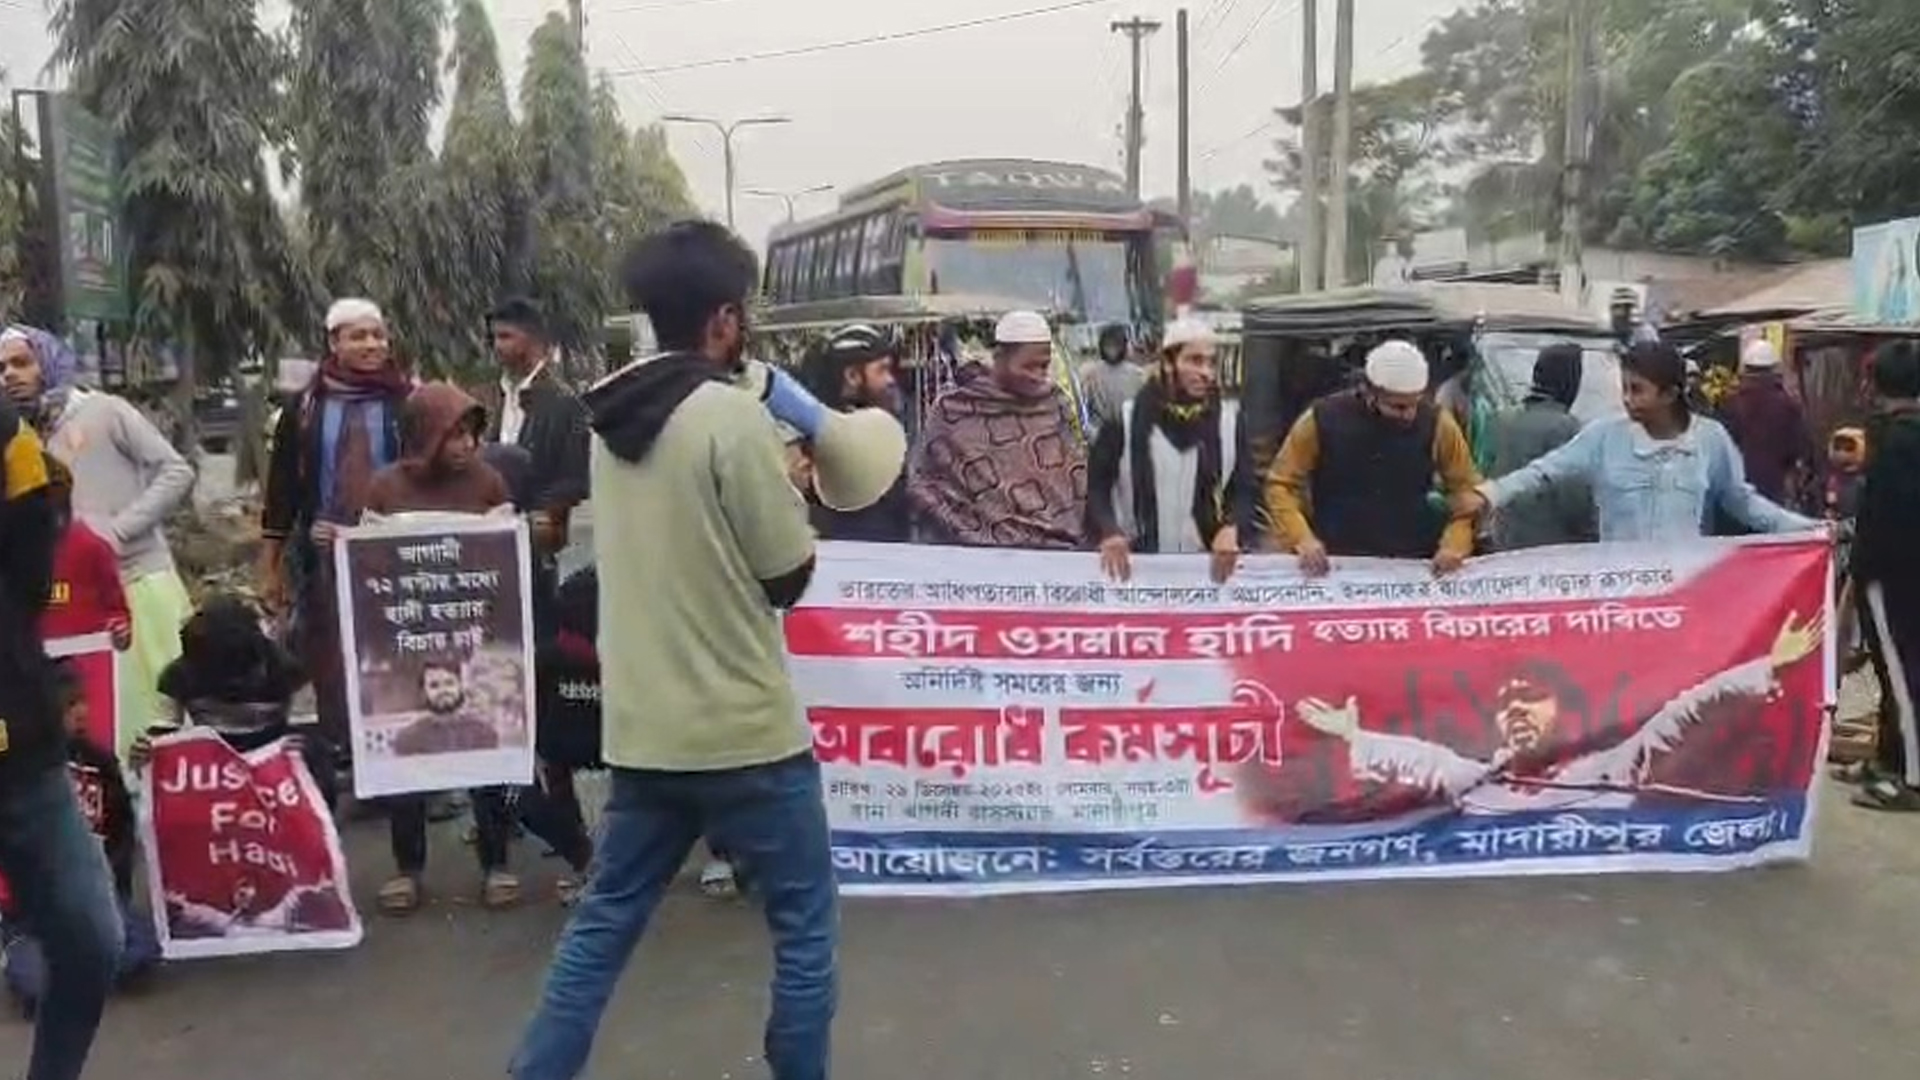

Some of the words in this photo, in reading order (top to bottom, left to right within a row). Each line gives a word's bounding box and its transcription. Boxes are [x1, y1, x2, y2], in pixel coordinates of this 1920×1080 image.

[843, 610, 978, 656] শহীদ
[998, 622, 1166, 656] ওসমান
[1186, 613, 1296, 657] হাদি
[1311, 614, 1408, 642] হত্যার
[1422, 609, 1552, 640] বিচারের
[1564, 603, 1686, 634] দাবিতে
[993, 672, 1066, 695] সময়ের
[1074, 672, 1121, 694] জন্য
[806, 704, 1046, 777] অবরোধ
[210, 801, 278, 834] For
[1288, 832, 1437, 866] জনগণ,
[1454, 814, 1671, 855] মাদারীপুর
